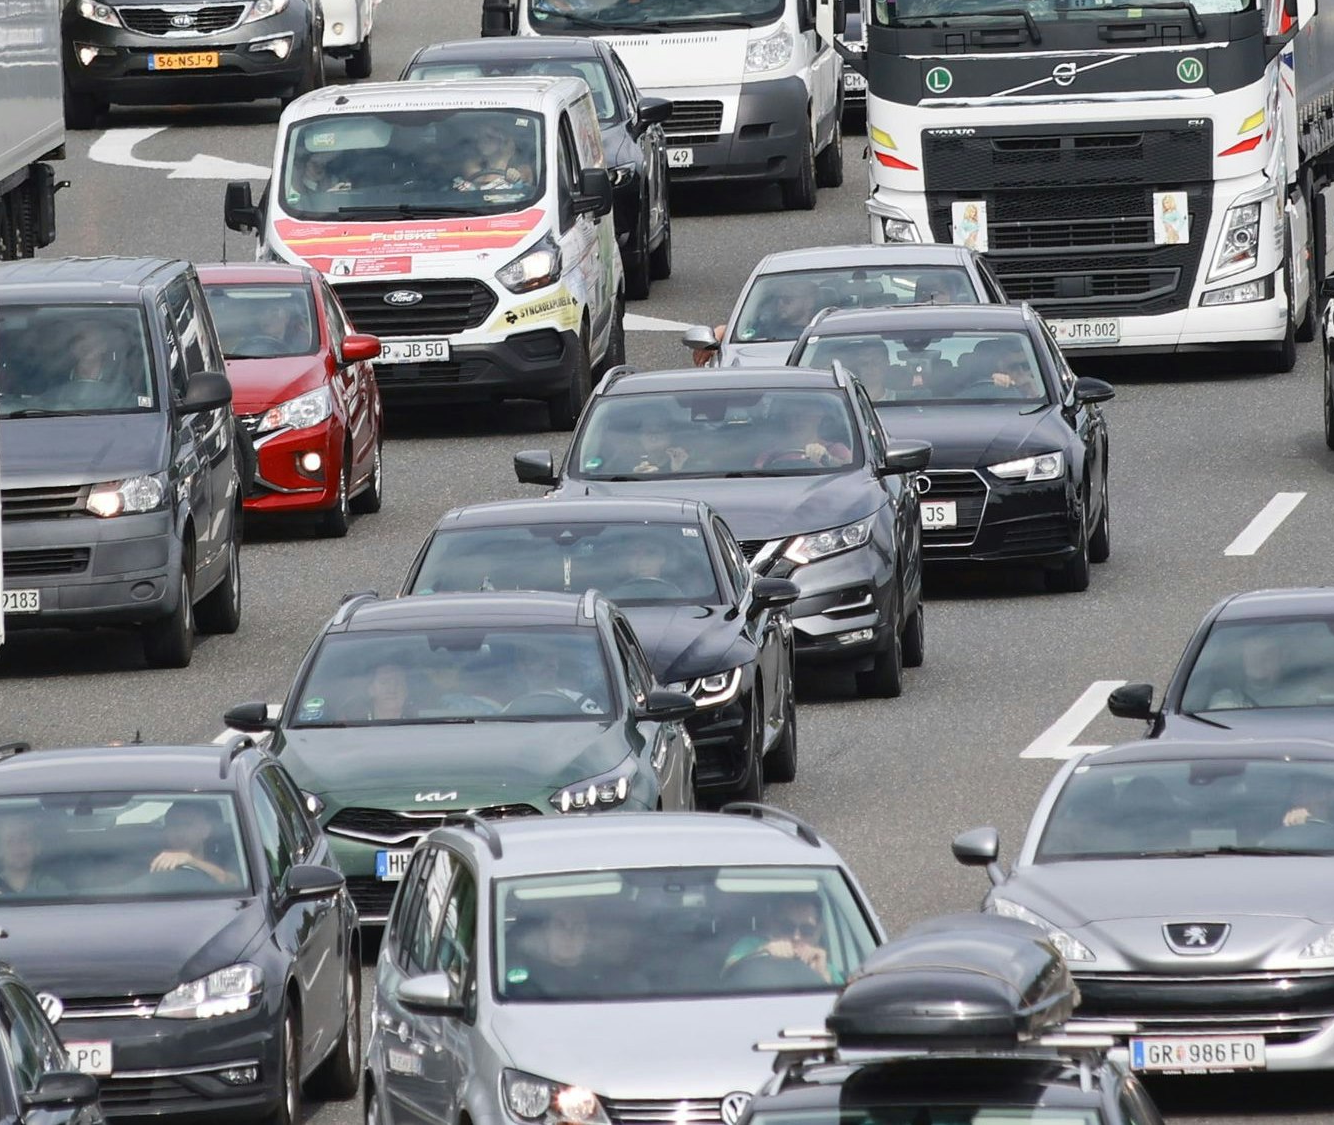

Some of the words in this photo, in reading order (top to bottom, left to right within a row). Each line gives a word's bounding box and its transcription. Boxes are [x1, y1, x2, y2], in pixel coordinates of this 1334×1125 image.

[157, 54, 214, 68] 56-NSJ-9
[1180, 62, 1199, 79] VI
[933, 72, 947, 89] L
[672, 150, 689, 163] 49
[389, 290, 414, 303] Ford
[403, 344, 422, 358] JB
[425, 342, 444, 357] 50
[926, 506, 945, 522] JS
[77, 1048, 102, 1069] PC
[1148, 1044, 1173, 1064] GR
[1188, 1042, 1227, 1063] 986
